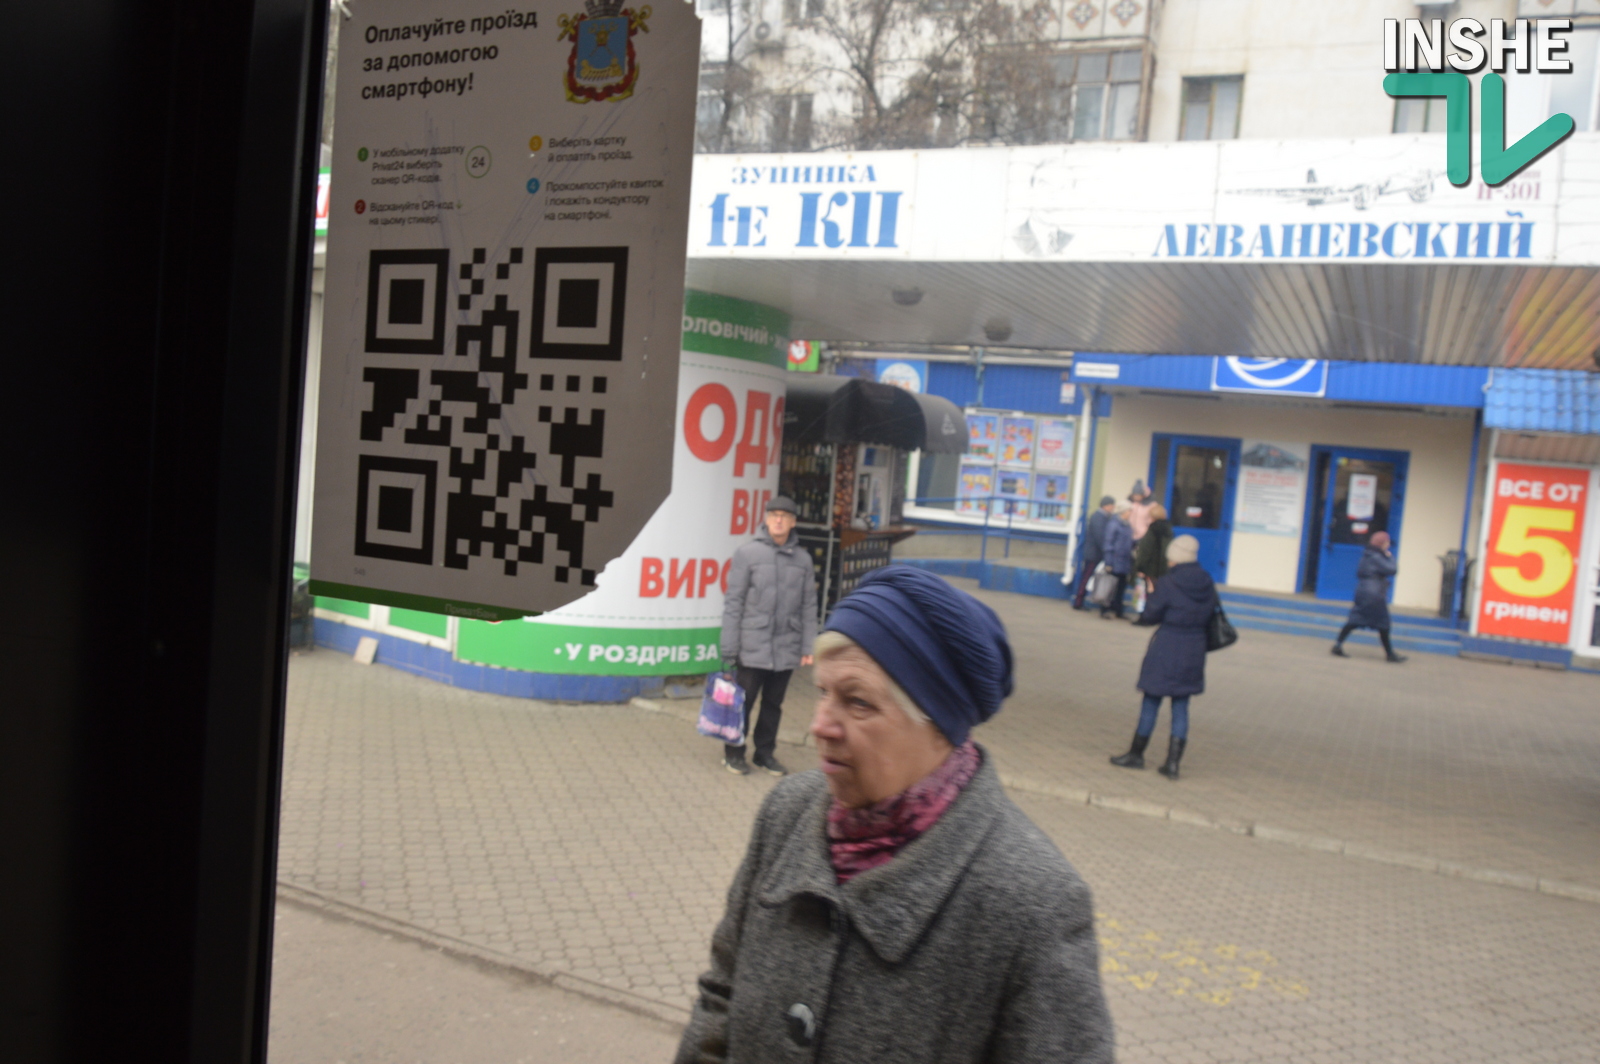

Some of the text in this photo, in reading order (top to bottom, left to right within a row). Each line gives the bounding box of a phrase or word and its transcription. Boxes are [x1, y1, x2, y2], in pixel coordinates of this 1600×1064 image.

[365, 9, 538, 44] Оплачуйте проїзд
[363, 45, 499, 72] за допомогою
[361, 72, 475, 101] смартфону!
[471, 156, 486, 169] 24
[731, 164, 878, 185] ЗУПИНКА
[1152, 210, 1535, 258] ЛЕВАНЕВСКИЙ
[1498, 478, 1584, 503] ВСЕ ОТ
[1489, 504, 1576, 598] 5
[1483, 600, 1569, 625] гривен
[588, 644, 691, 666] РОЗДРІБ
[694, 644, 719, 664] ЗА
